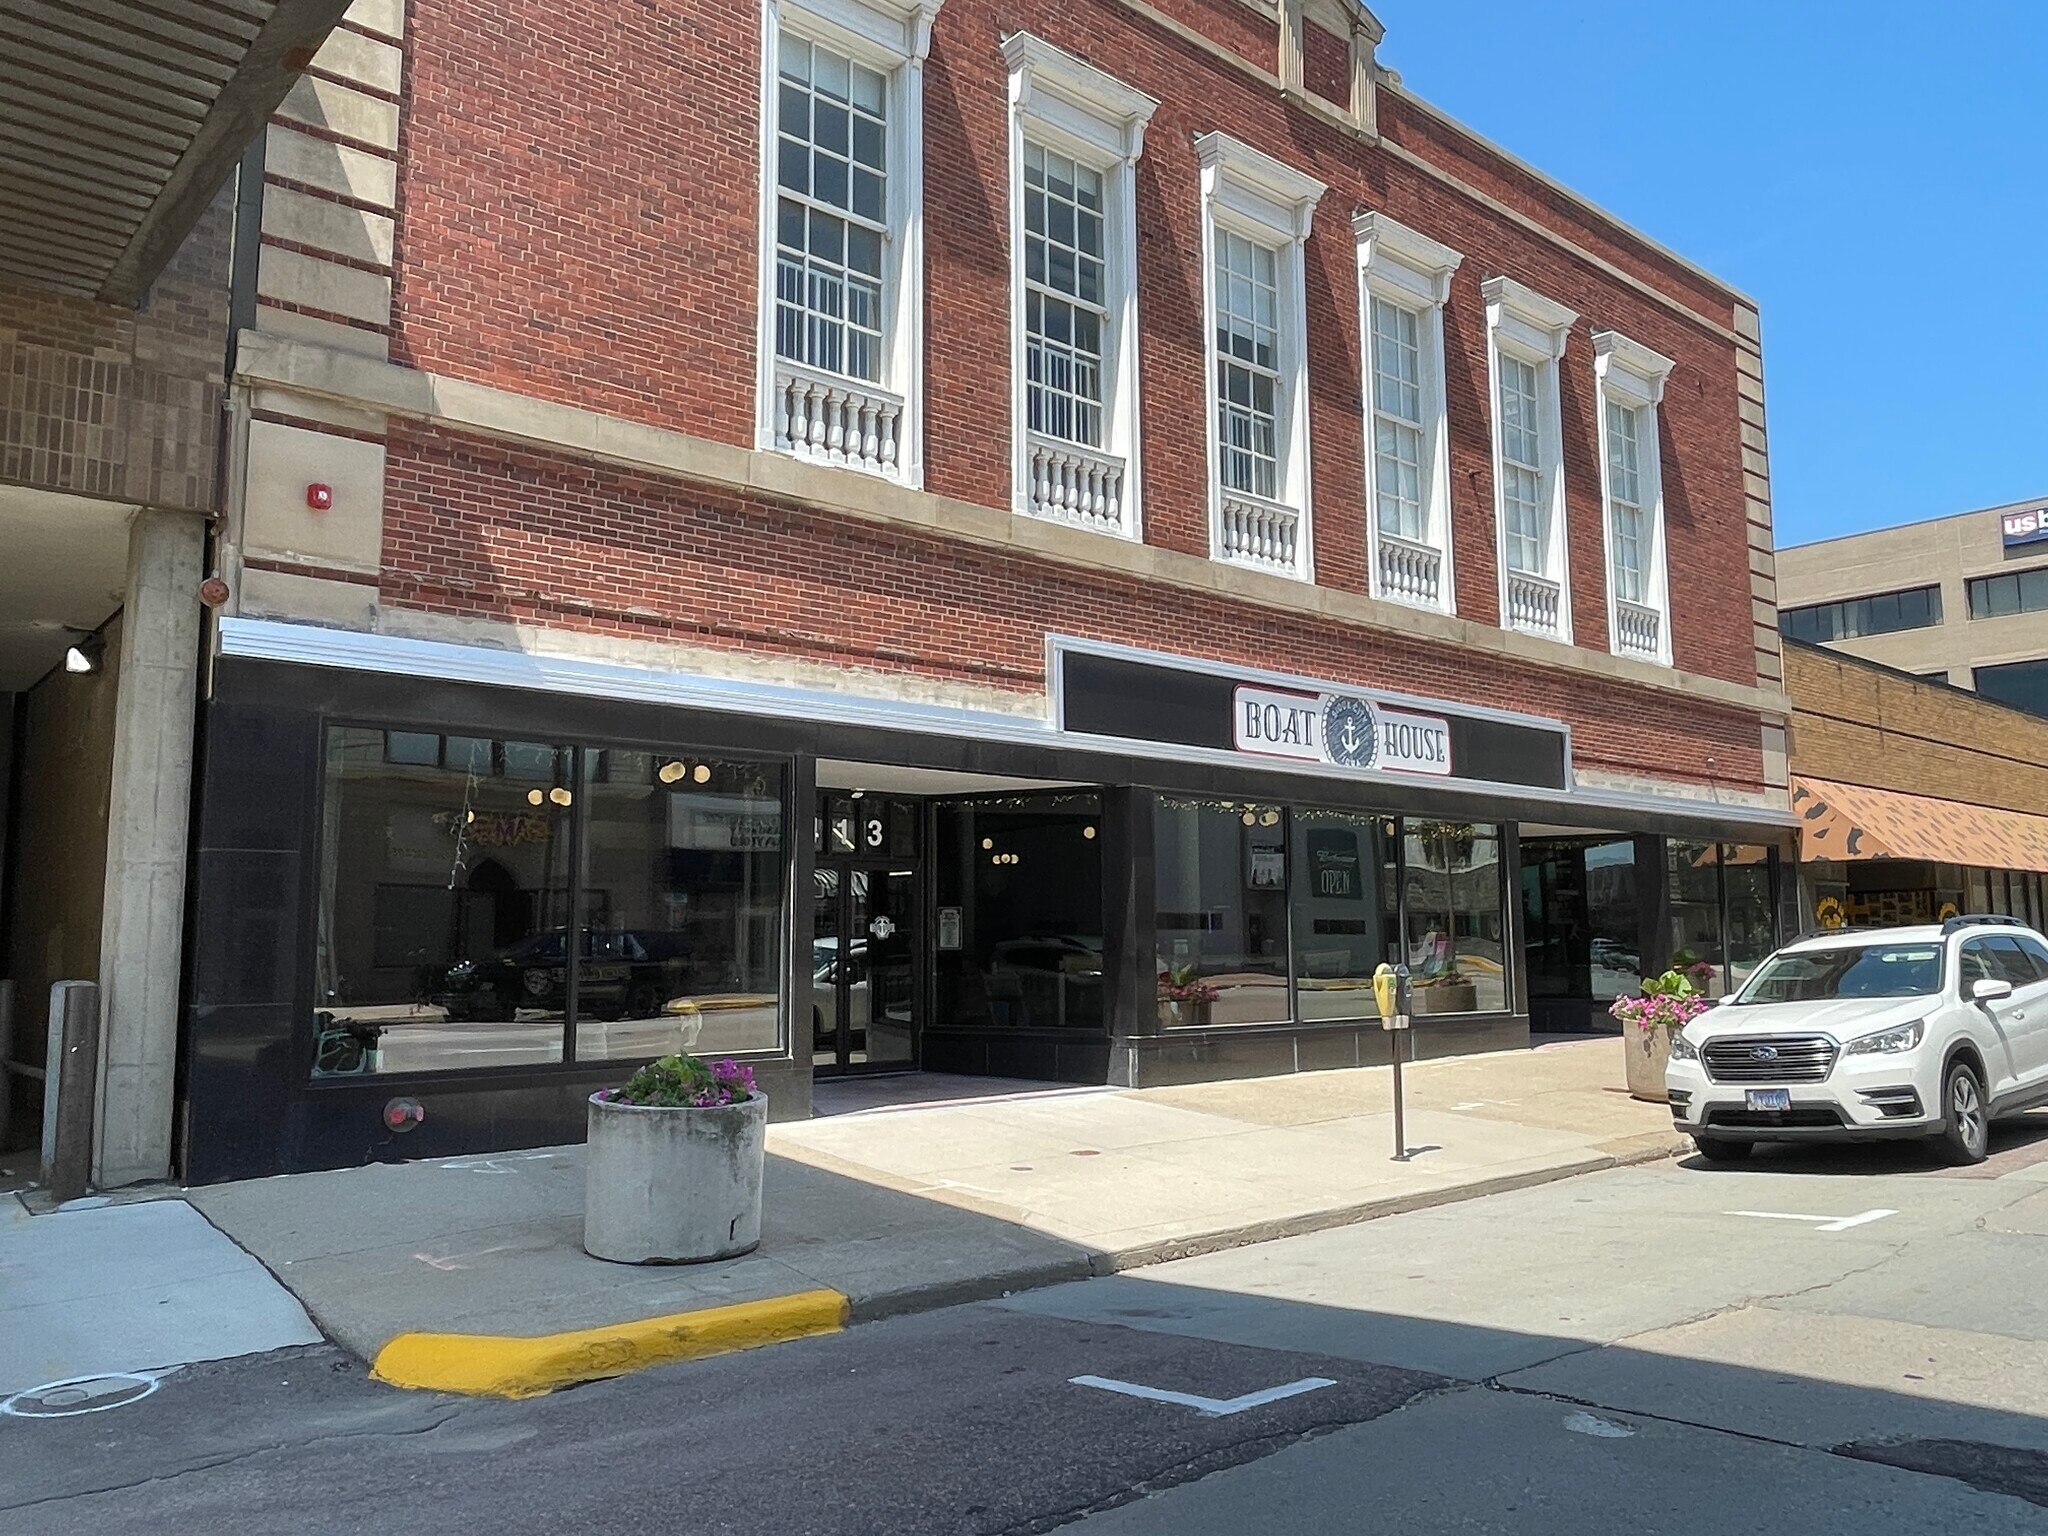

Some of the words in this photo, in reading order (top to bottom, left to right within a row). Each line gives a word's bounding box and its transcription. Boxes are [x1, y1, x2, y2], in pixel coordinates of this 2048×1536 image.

[1244, 701, 1316, 747] BOAT
[1384, 722, 1445, 763] HOUSE
[1321, 869, 1350, 894] OPEN
